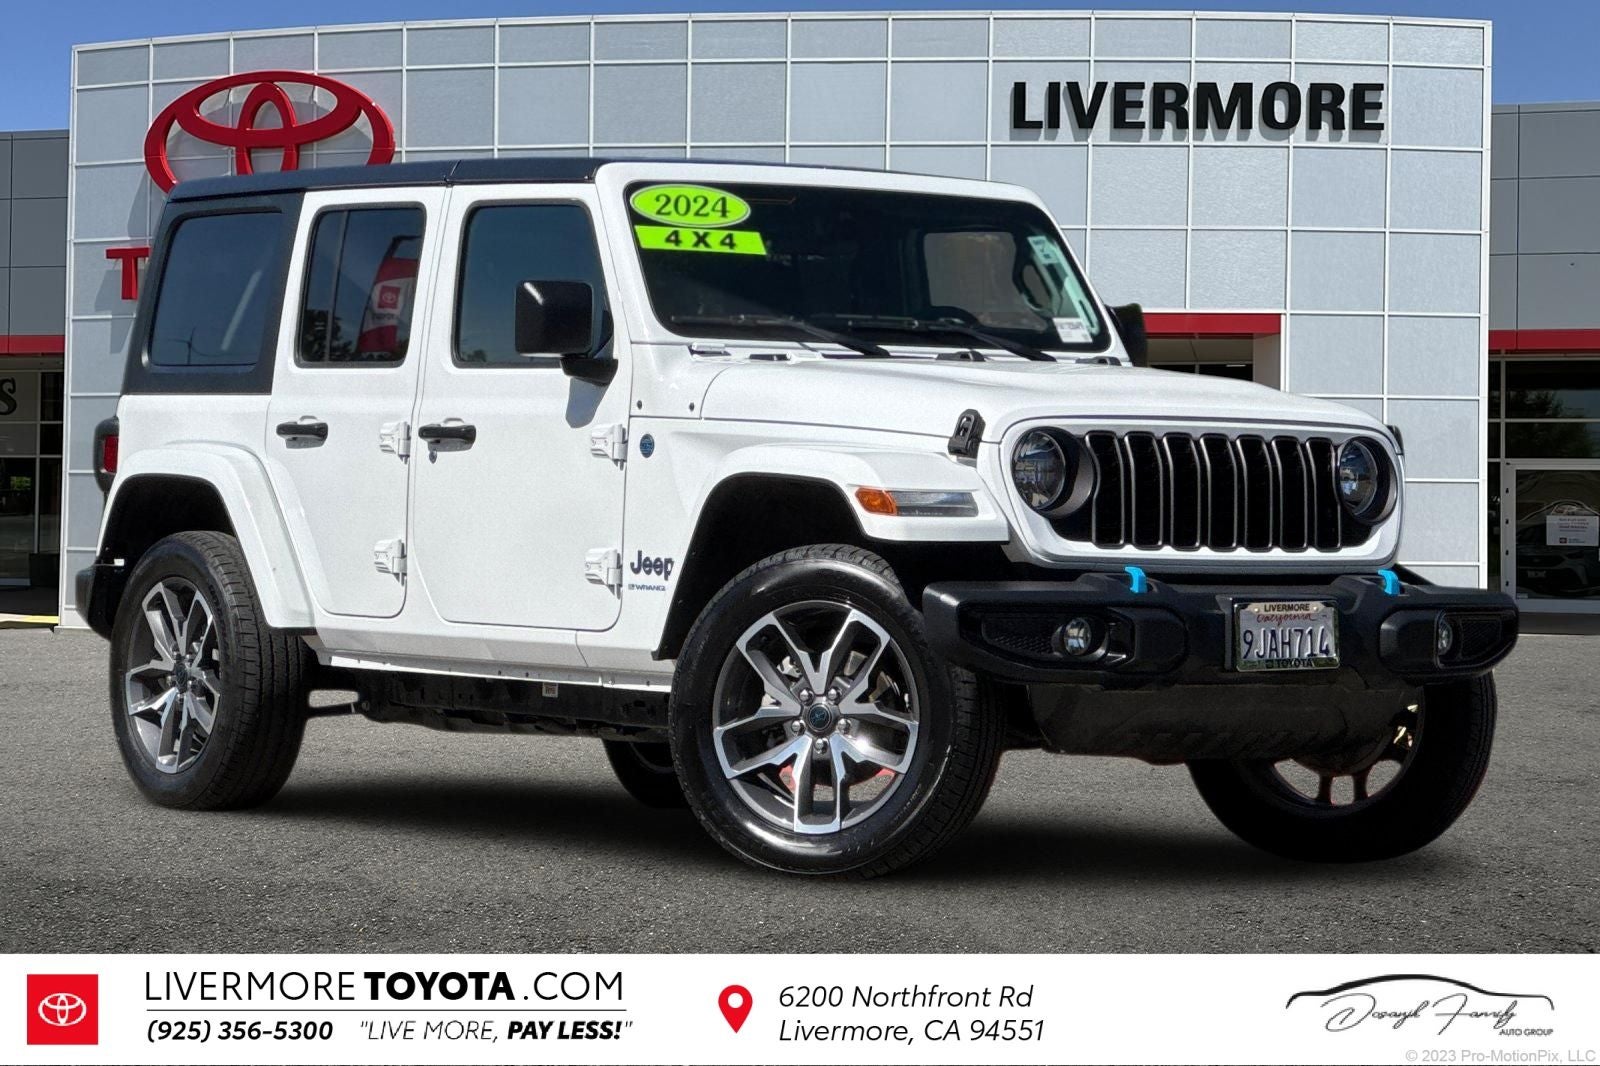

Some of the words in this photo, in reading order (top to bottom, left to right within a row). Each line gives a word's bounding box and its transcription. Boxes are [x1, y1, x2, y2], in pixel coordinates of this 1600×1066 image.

[1012, 81, 1385, 131] LIVERMORE
[654, 193, 731, 219] 2024
[630, 550, 675, 581] Jeep
[1264, 603, 1311, 613] LIVERMORE
[1242, 627, 1331, 660] 9JAH714
[1277, 658, 1314, 669] TOYOTA
